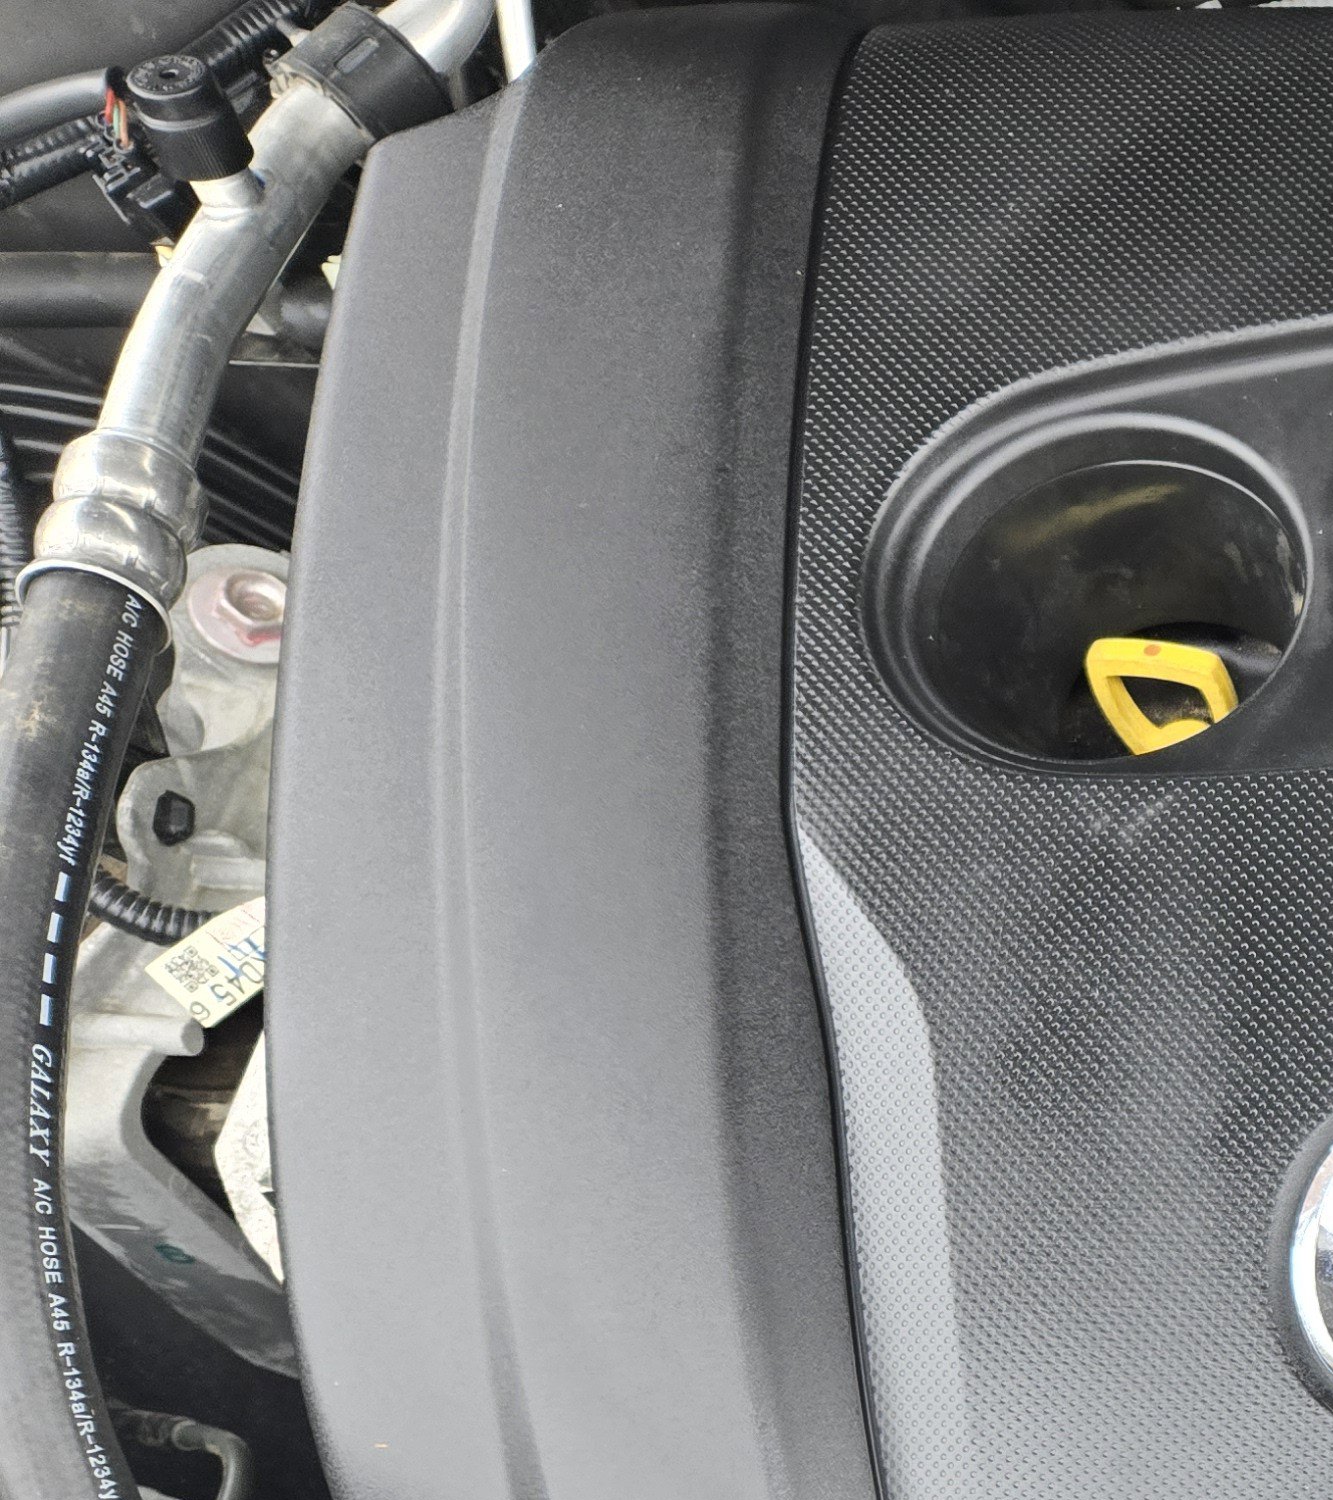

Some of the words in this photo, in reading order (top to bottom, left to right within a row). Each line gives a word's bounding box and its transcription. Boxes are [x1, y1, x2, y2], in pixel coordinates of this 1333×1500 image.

[119, 593, 145, 630] A/C
[105, 629, 134, 682] HOSE
[95, 684, 121, 719] A45
[29, 1043, 53, 1167] GALAXY
[32, 1178, 53, 1215] A/C
[38, 1225, 63, 1284] HOSE
[47, 1291, 72, 1333] A45
